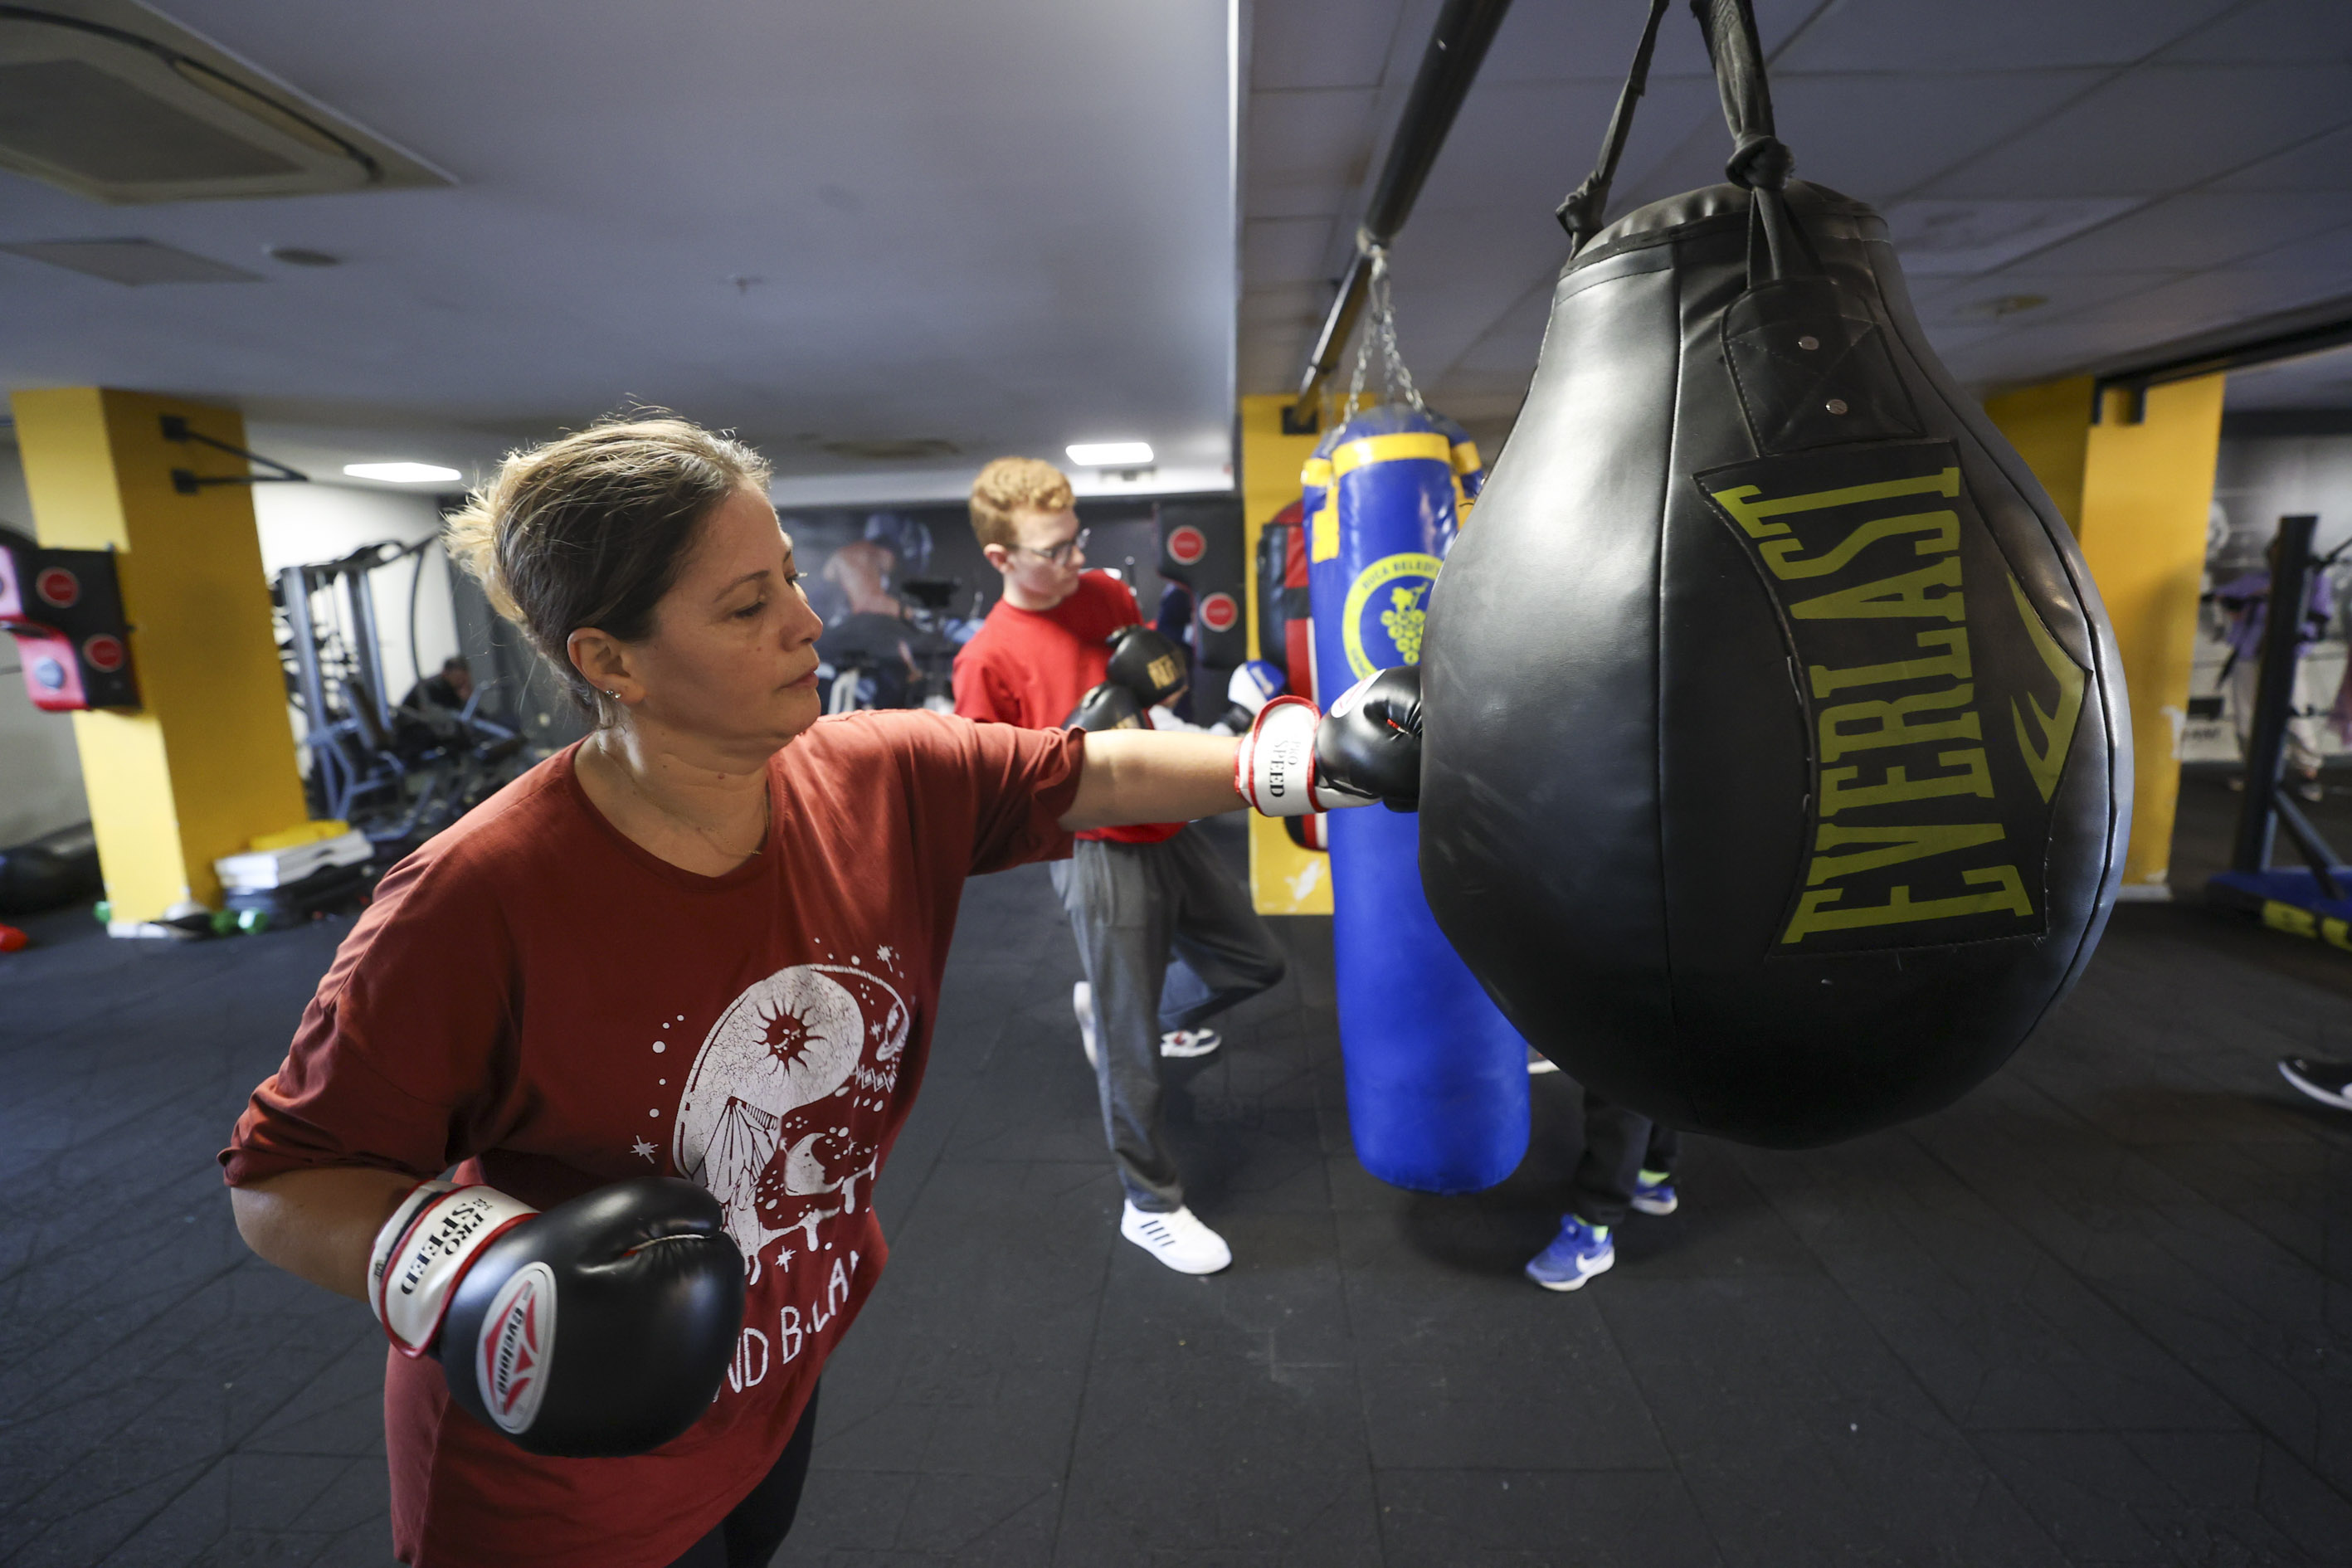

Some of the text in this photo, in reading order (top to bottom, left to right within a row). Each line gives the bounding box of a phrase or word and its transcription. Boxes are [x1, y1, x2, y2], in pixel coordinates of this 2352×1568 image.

[1393, 561, 1438, 573] BELED
[1711, 467, 2033, 943] EVERLAST
[1269, 740, 1289, 797] SPEED
[1288, 741, 1302, 765] PRO
[402, 1203, 475, 1294] SPEED
[445, 1214, 484, 1255] PRO
[713, 1327, 769, 1403] ND
